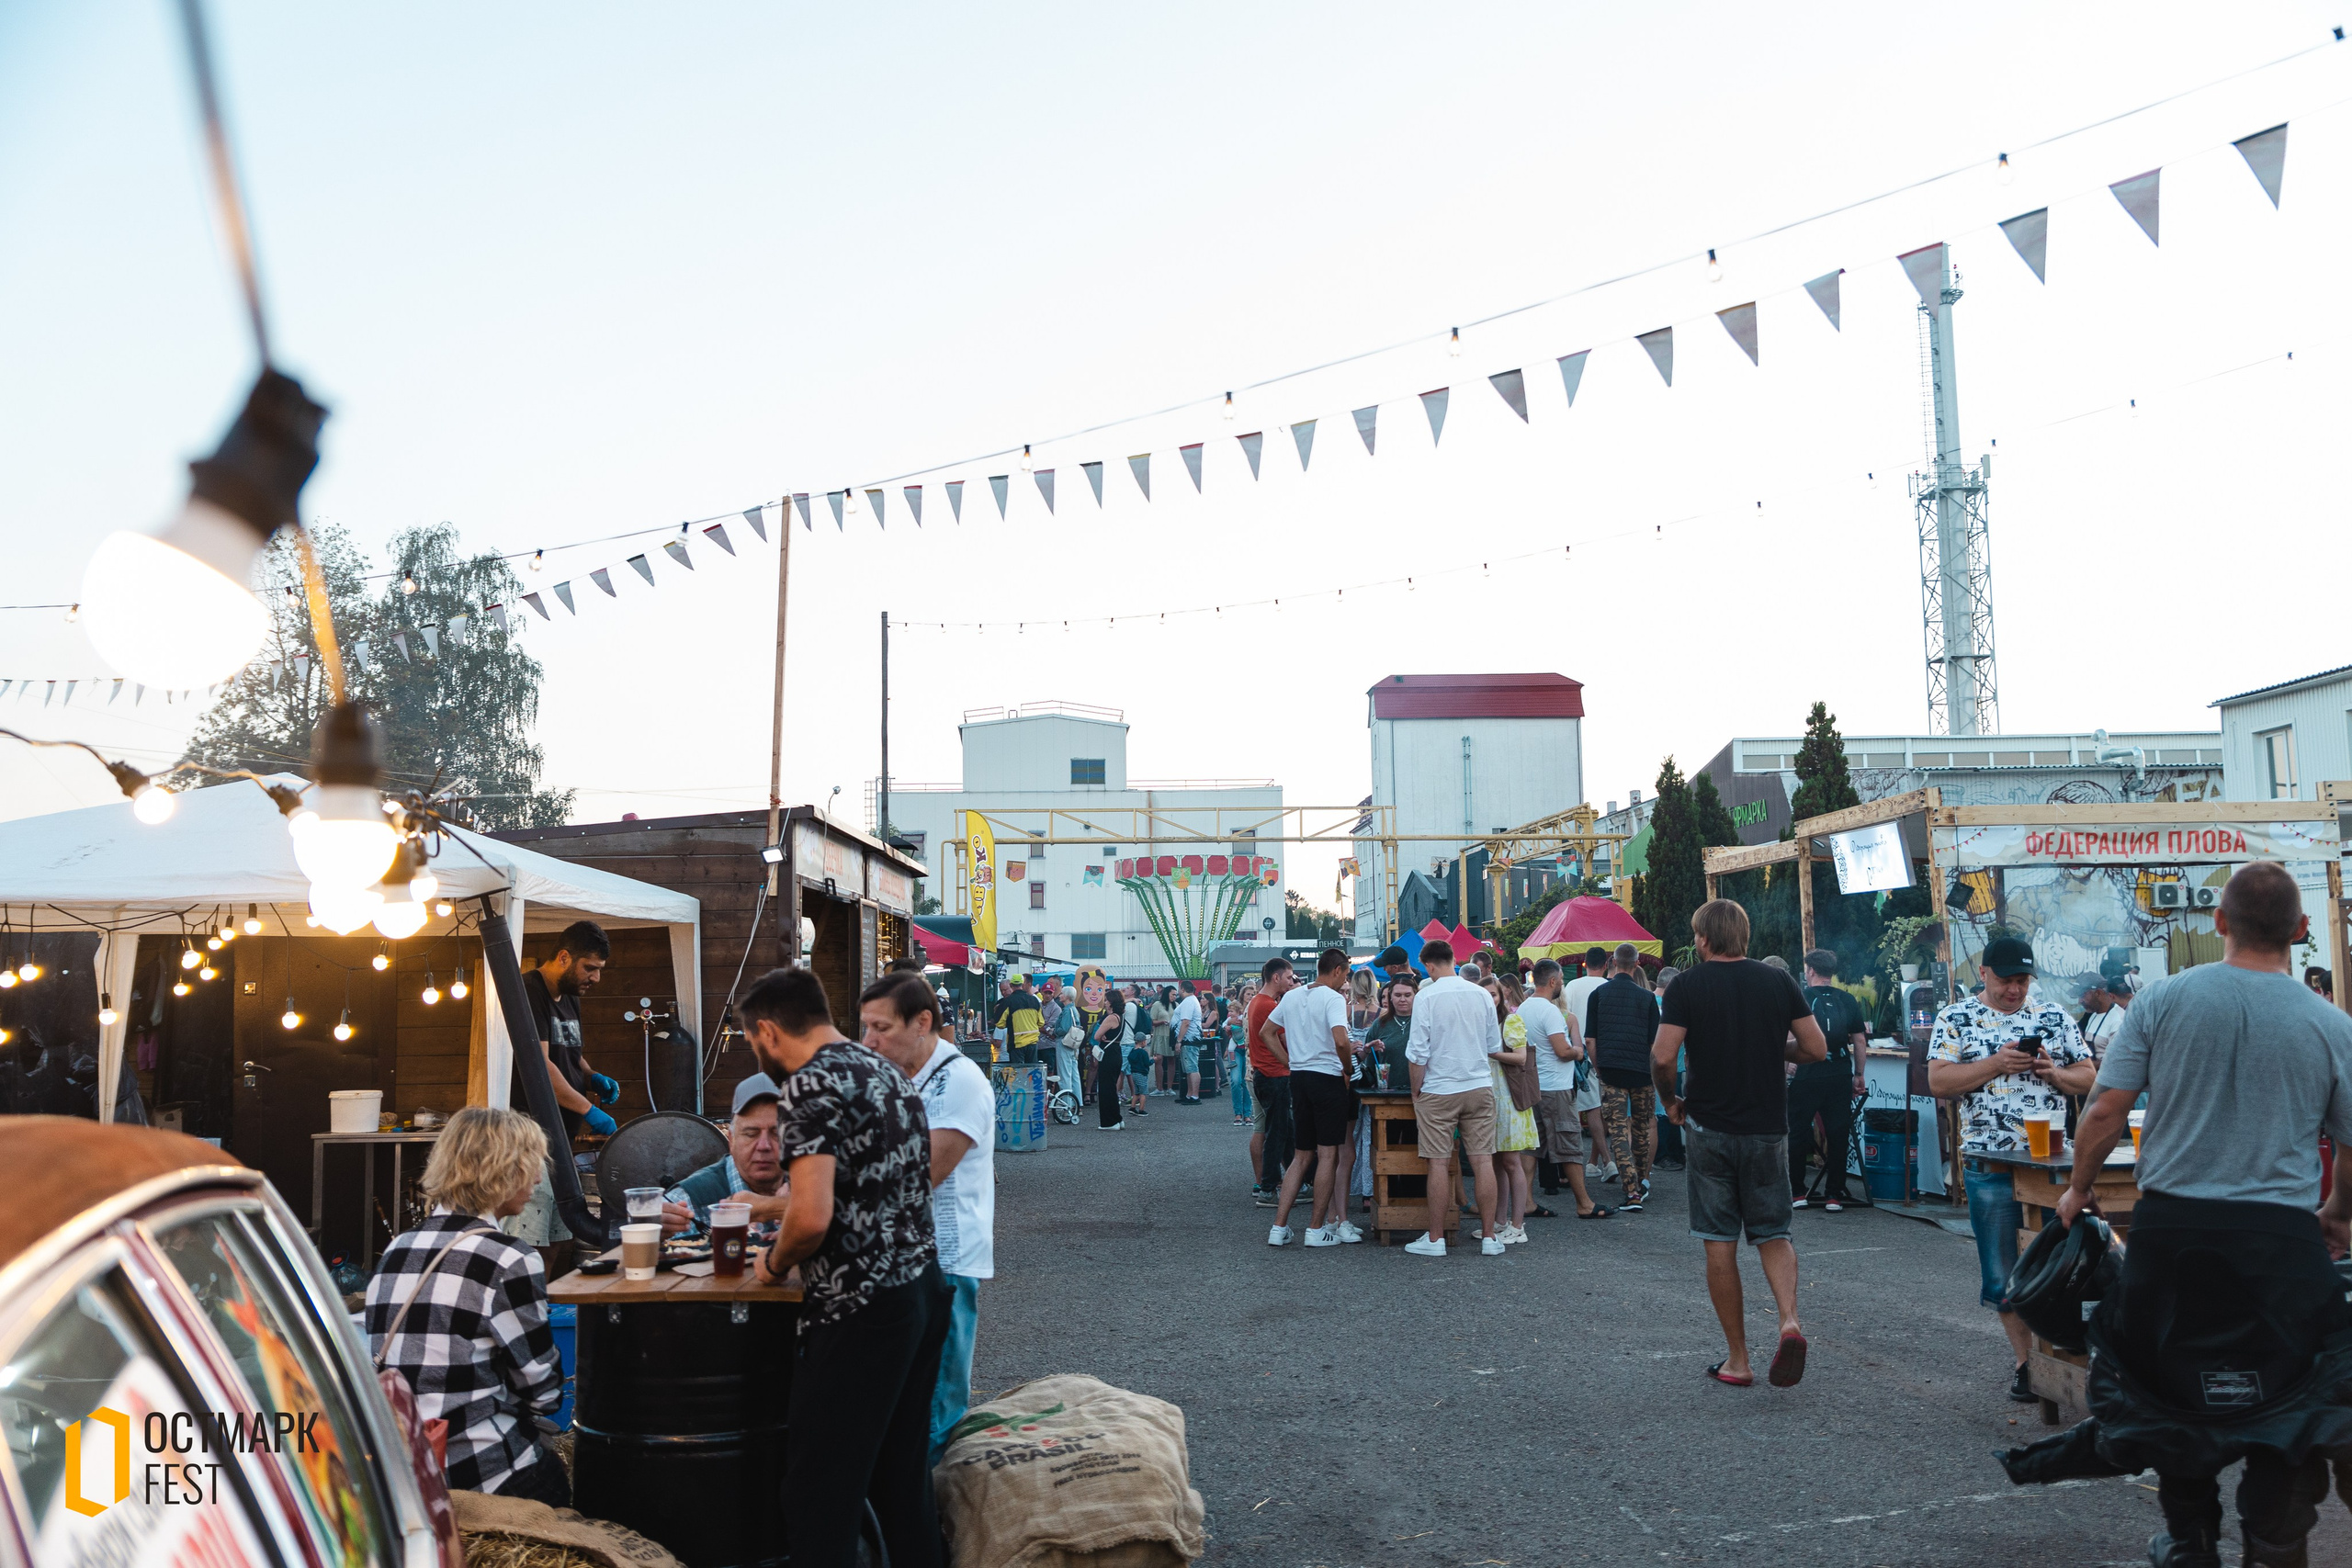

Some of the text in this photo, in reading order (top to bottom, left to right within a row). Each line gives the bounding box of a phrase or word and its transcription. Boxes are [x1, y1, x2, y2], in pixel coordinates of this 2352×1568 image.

[2025, 829, 2247, 859] ФЕДЕРАЦИЯ ПЛОВА
[989, 1443, 1093, 1470] BRASIL
